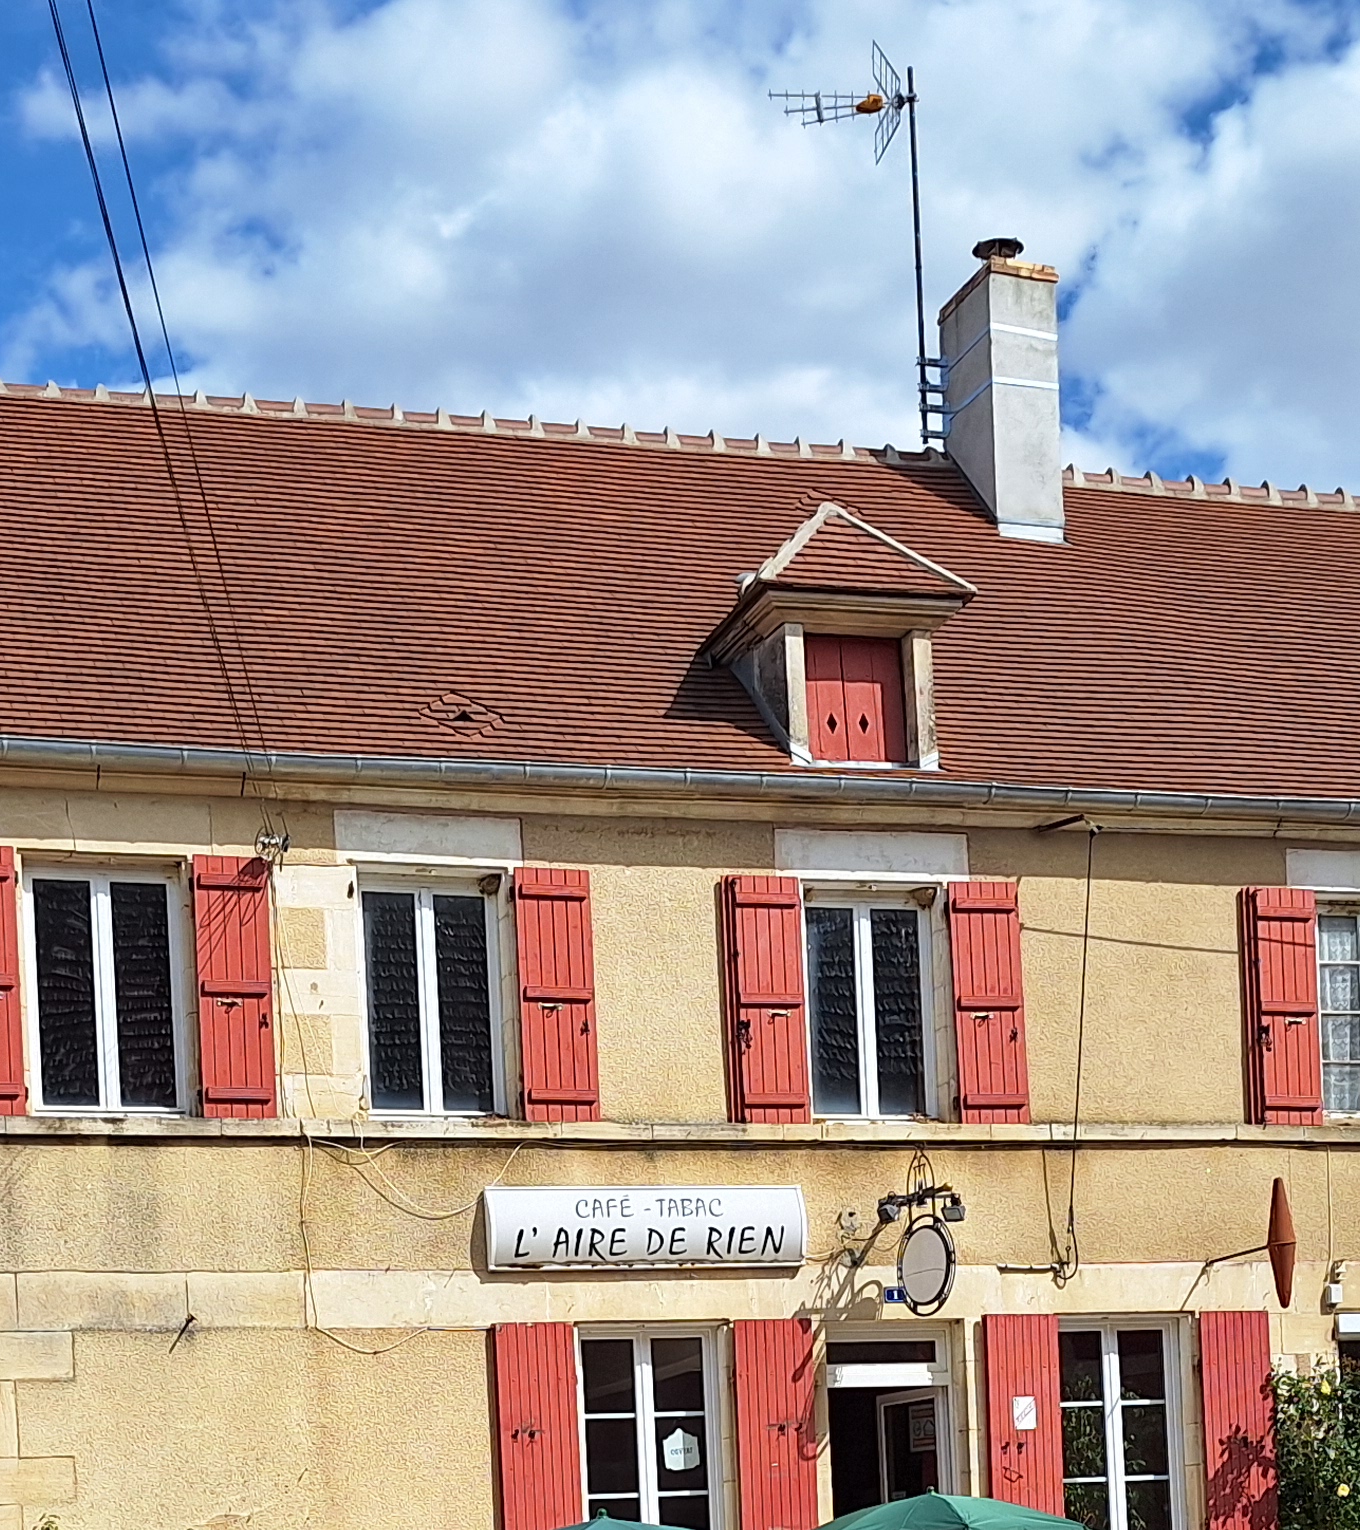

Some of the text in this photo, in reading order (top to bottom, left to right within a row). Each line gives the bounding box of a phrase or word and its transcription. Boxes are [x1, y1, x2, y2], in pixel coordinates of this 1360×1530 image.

[575, 1194, 635, 1219] CAFÉ
[552, 1226, 629, 1261] AIRE
[646, 1226, 688, 1257] DE
[705, 1225, 785, 1260] RIEN
[892, 1289, 899, 1300] 1
